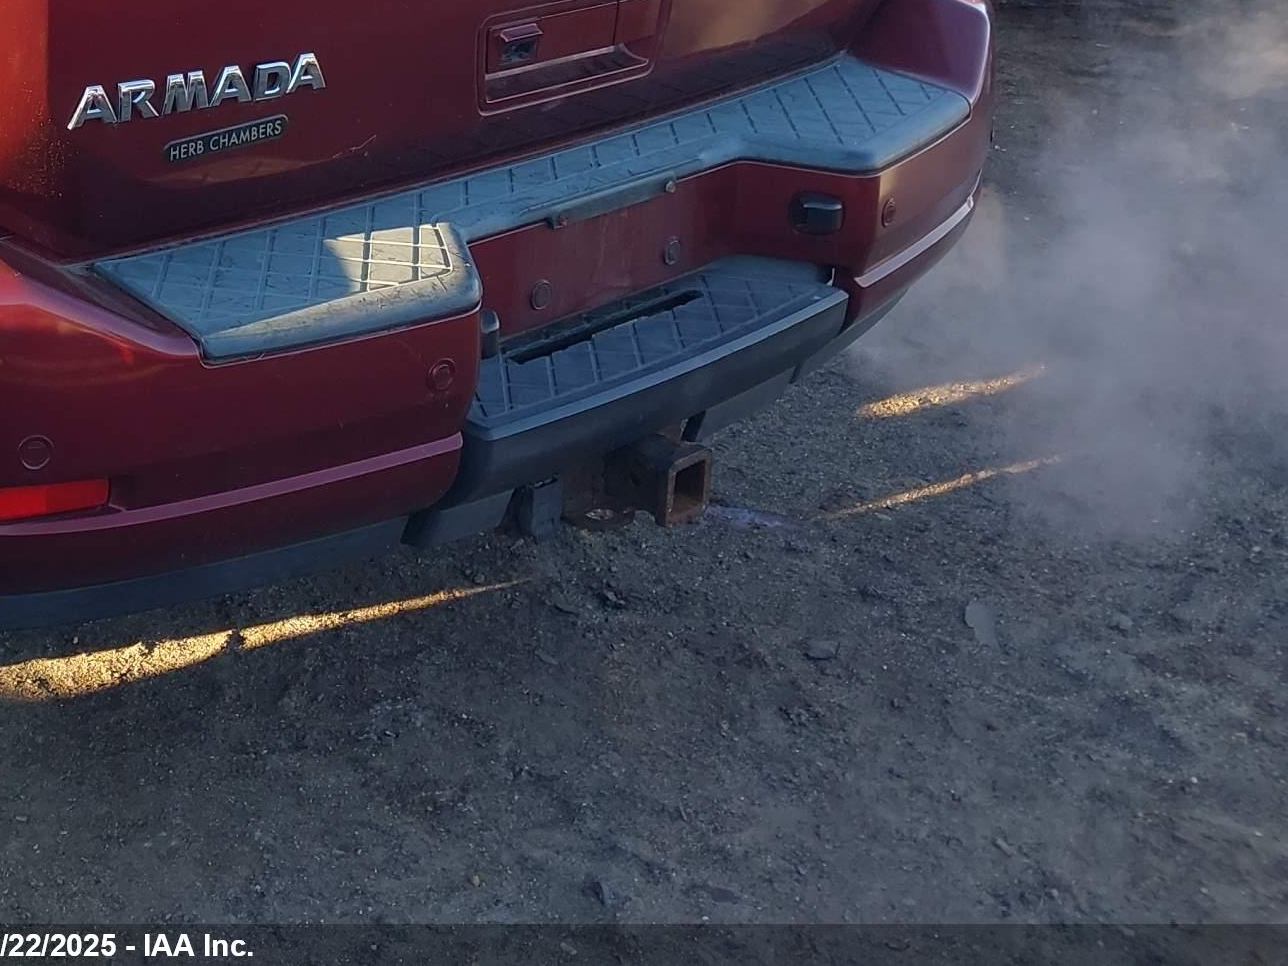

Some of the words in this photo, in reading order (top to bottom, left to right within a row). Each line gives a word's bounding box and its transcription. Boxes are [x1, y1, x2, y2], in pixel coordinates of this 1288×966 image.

[66, 52, 326, 131] ARMADA
[170, 140, 205, 162] HERB
[209, 120, 283, 151] CHAMBERS
